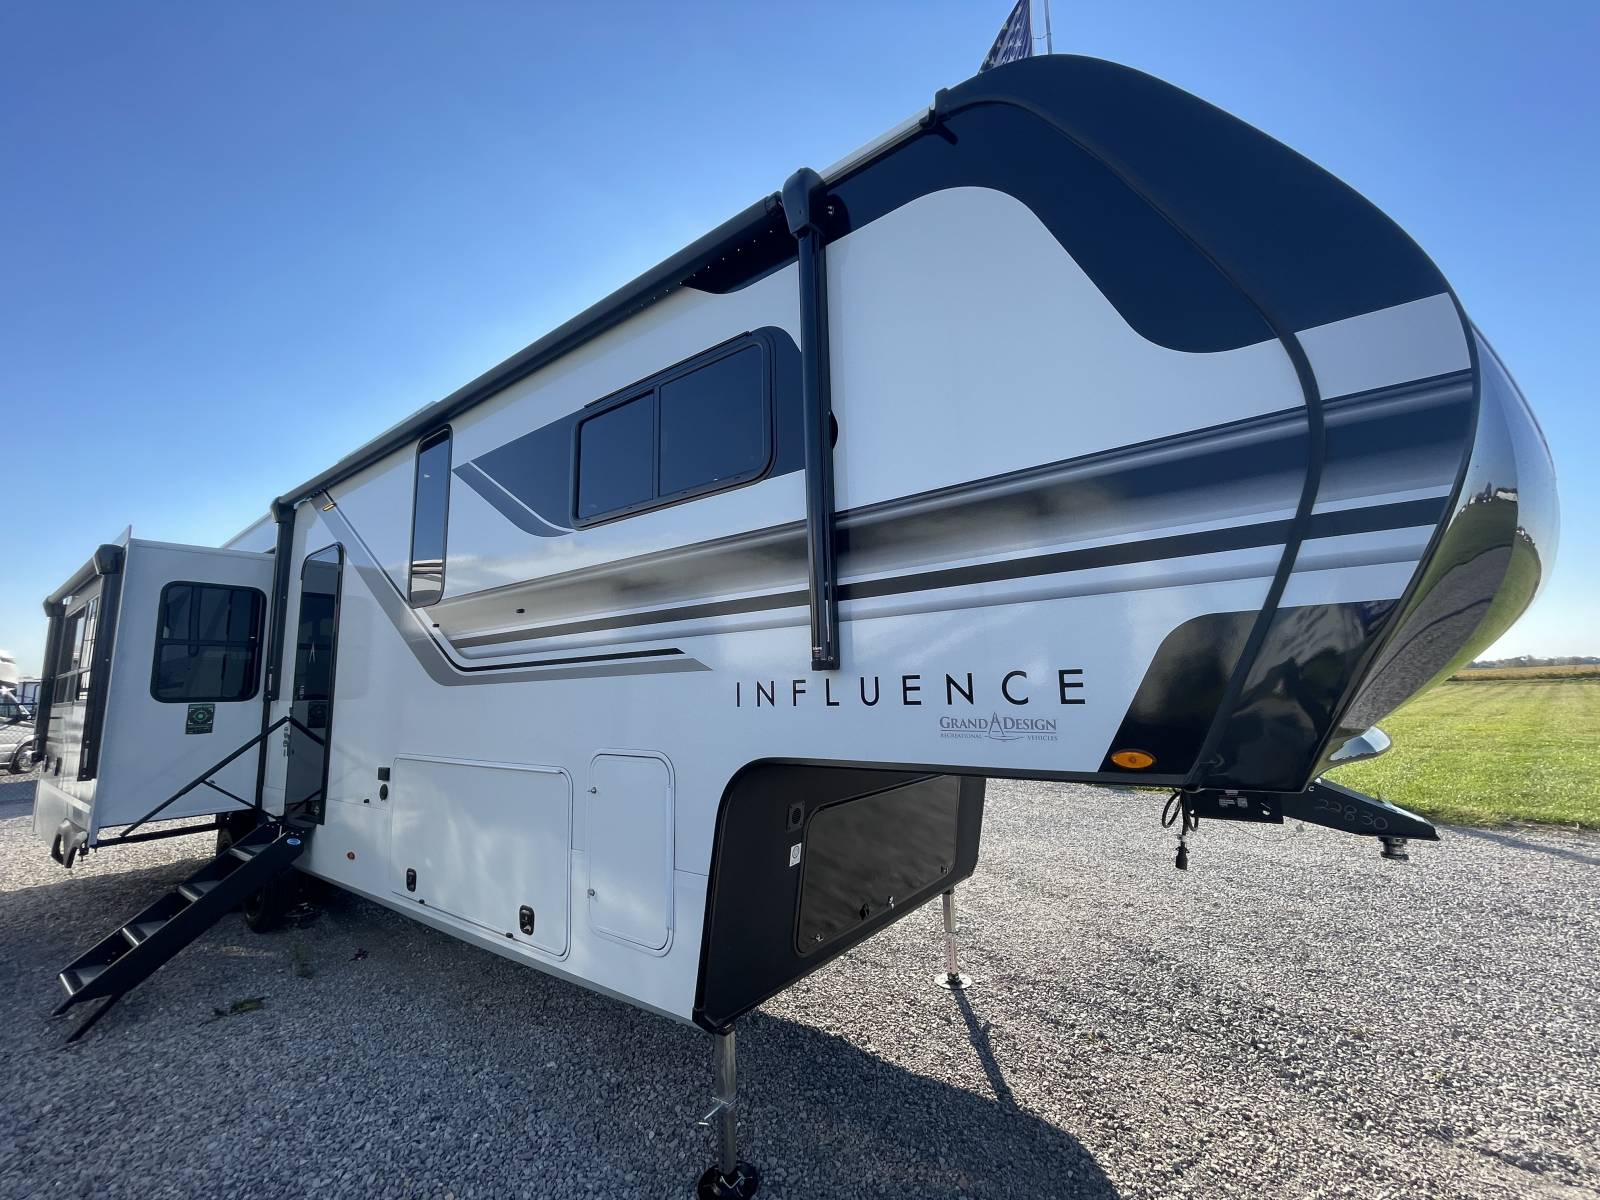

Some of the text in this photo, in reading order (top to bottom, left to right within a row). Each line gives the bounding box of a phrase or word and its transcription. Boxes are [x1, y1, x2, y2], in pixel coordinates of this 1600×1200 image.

[736, 668, 1087, 708] INFLUENCE
[939, 716, 1057, 731] GRAND DESIGN
